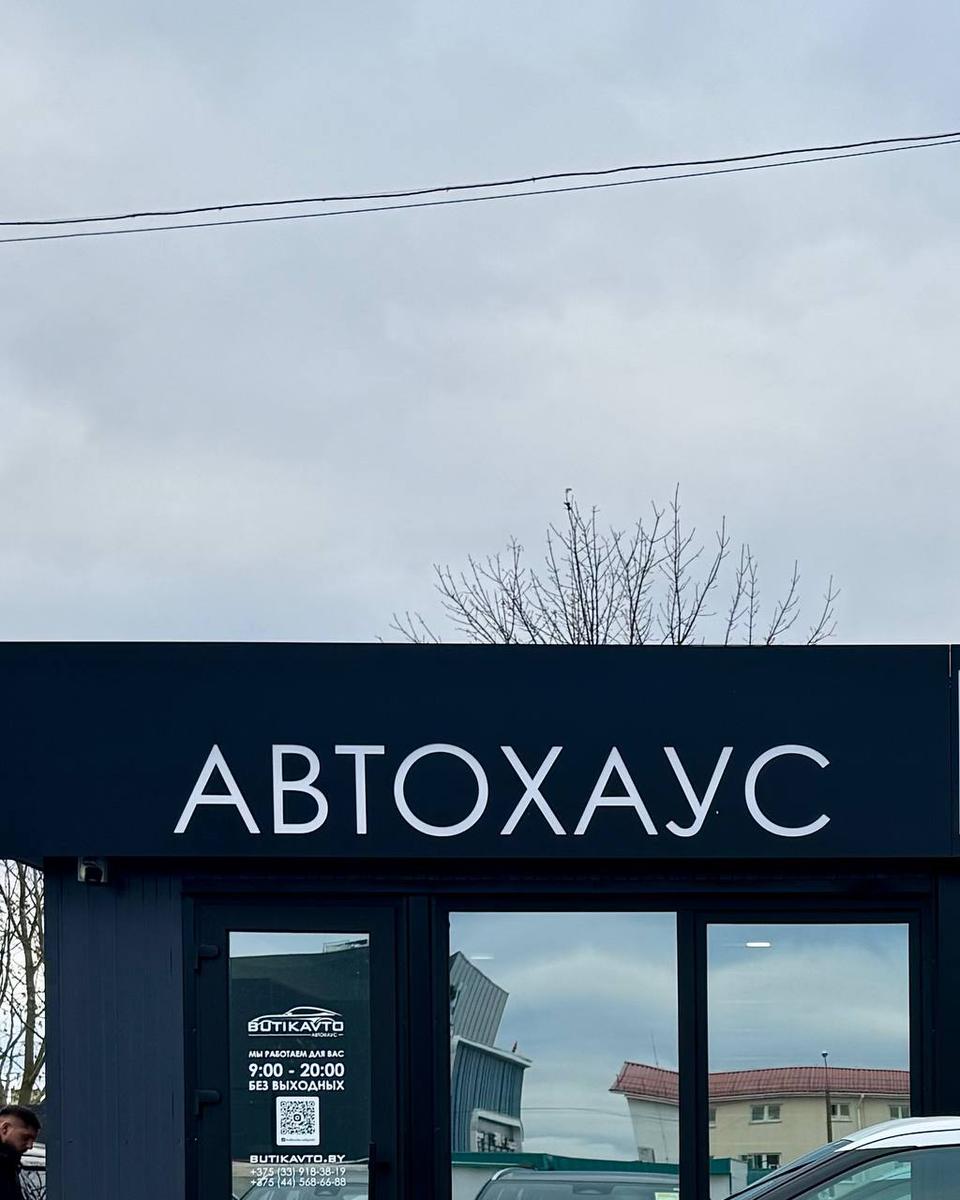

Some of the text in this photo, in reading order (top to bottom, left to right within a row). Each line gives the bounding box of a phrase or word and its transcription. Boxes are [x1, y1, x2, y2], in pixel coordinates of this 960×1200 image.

[173, 743, 831, 838] АВТОХАУС
[247, 1021, 344, 1032] BUTIKAVTO
[248, 1050, 345, 1058] МЫ РАБОТАЕМ ДЛЯ ВАС
[248, 1063, 283, 1077] 9:00
[300, 1063, 345, 1077] 20:00
[248, 1081, 345, 1092] БЕЗ ВЫХОДНЫХ
[249, 1154, 346, 1163] BUTIKAVTO.BY
[250, 1166, 346, 1178] +375 (33) 918-38-19
[250, 1177, 347, 1188] +375 (44) 568-66-88
